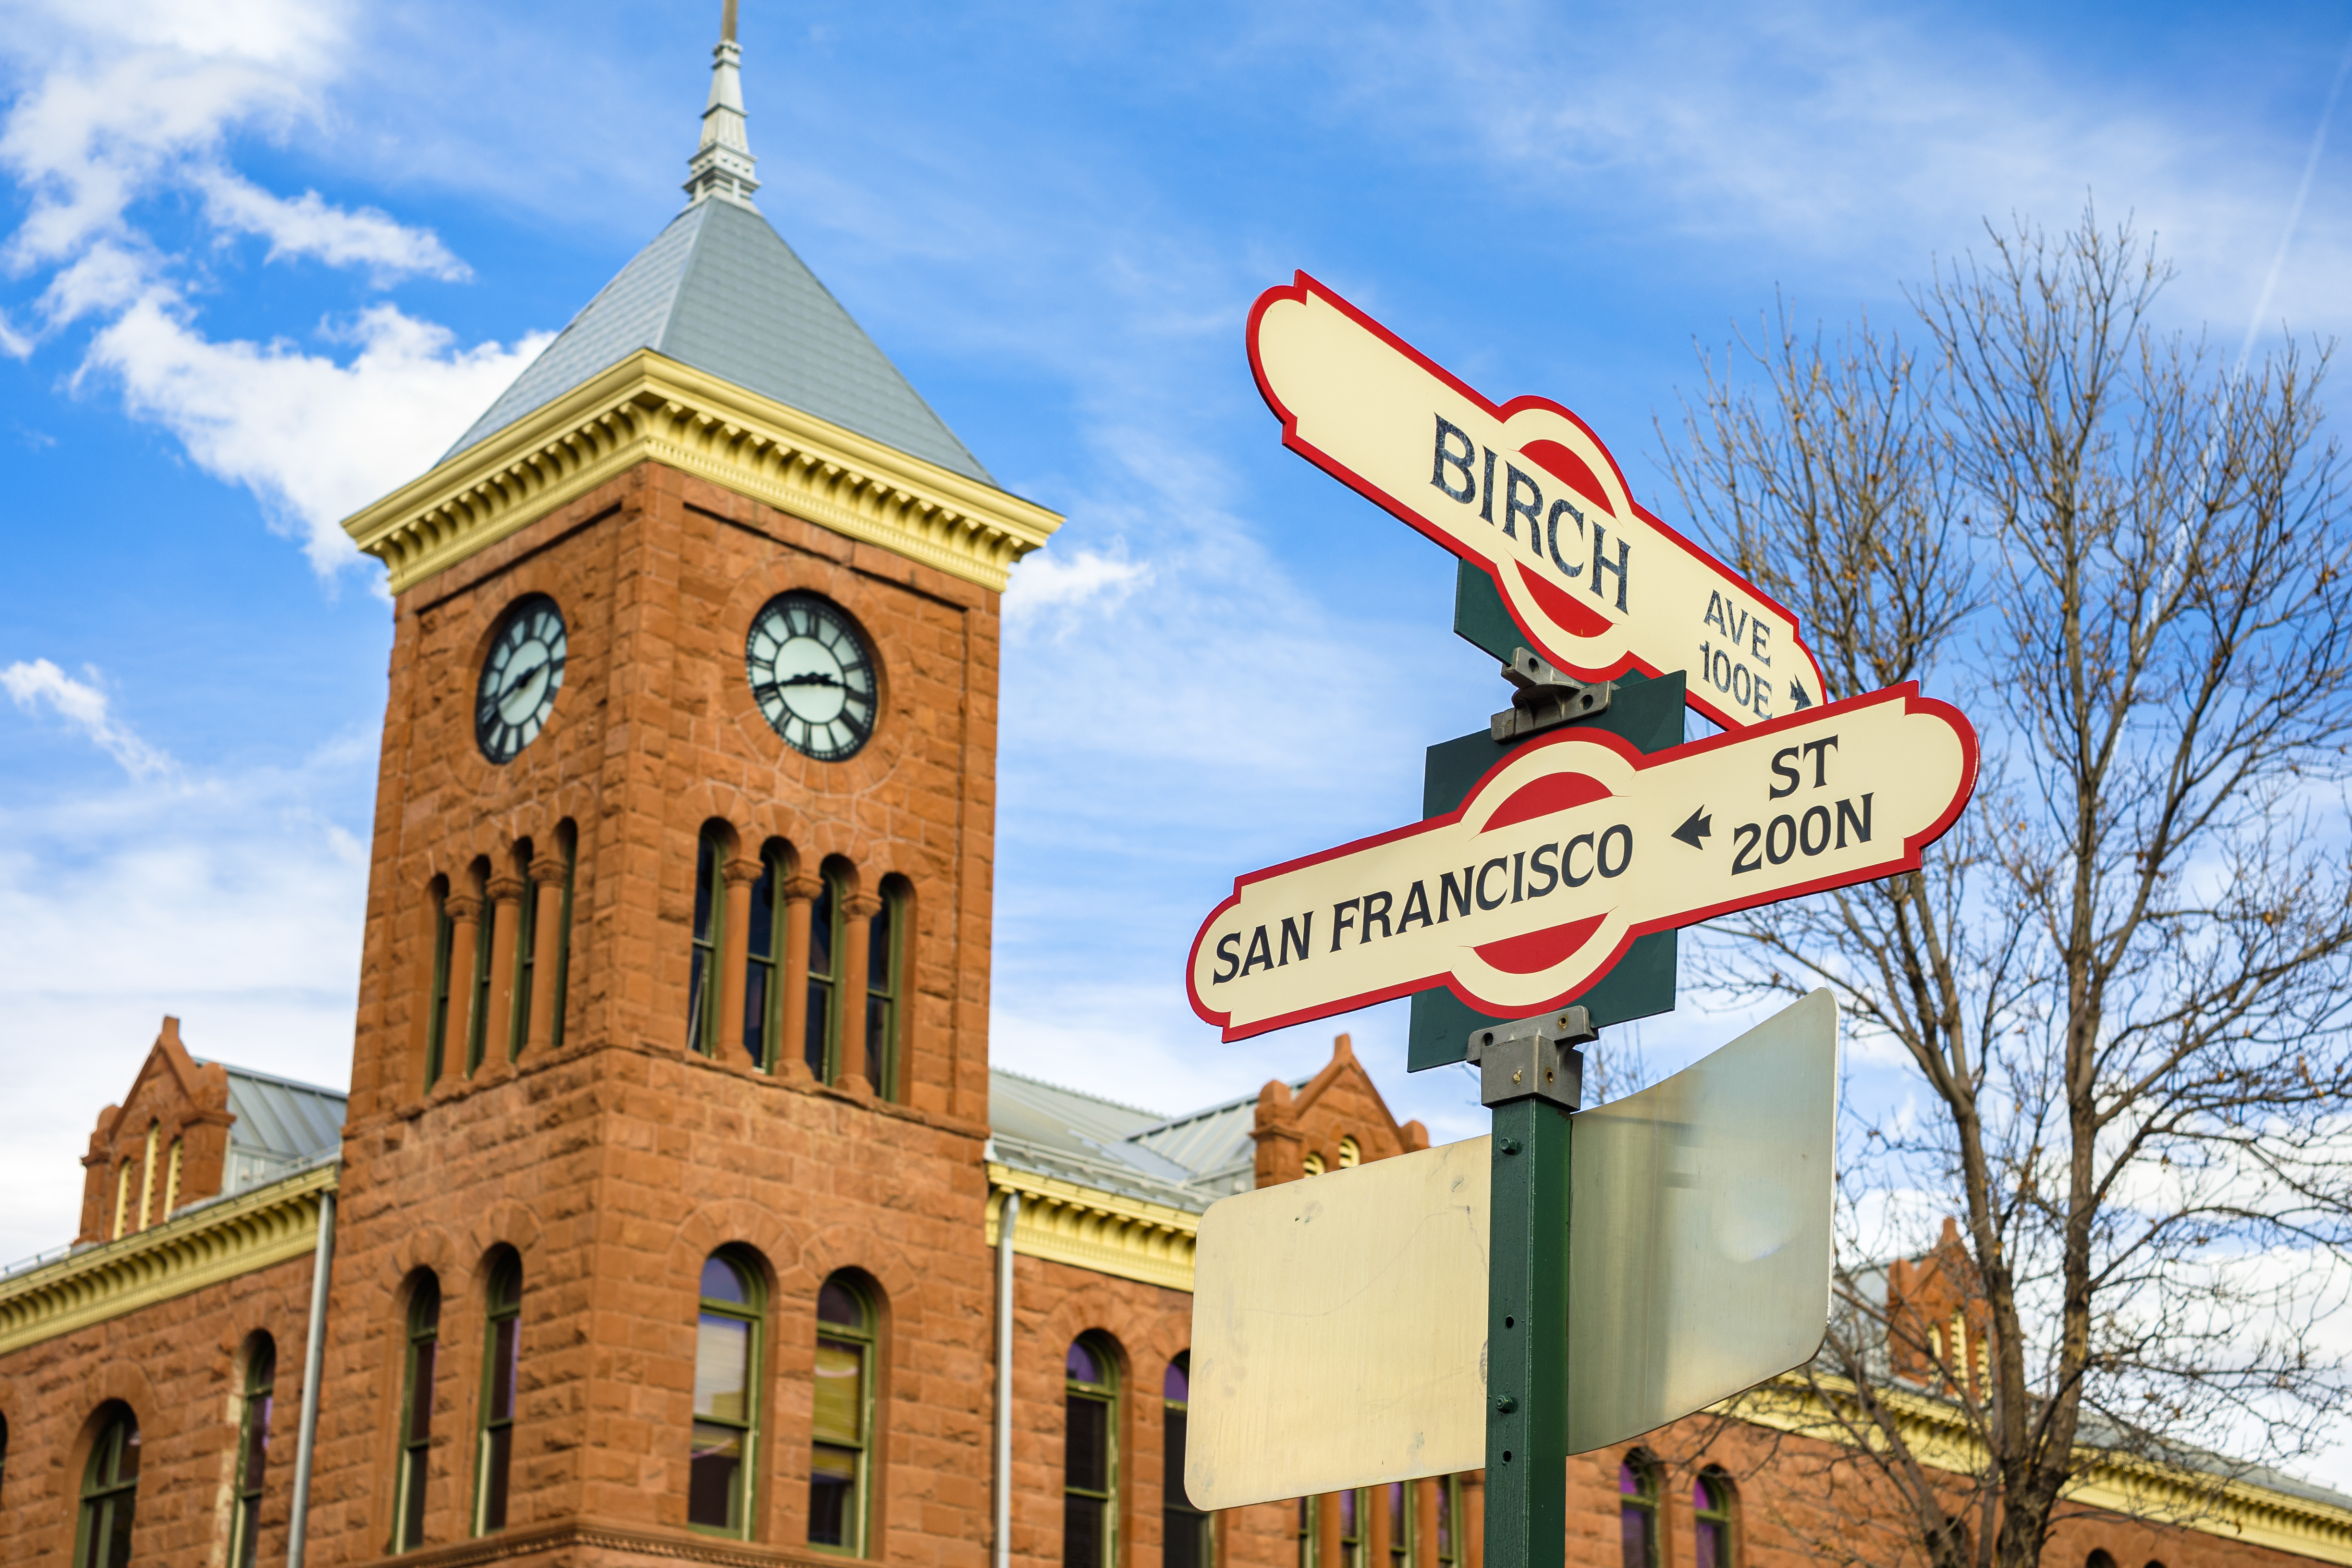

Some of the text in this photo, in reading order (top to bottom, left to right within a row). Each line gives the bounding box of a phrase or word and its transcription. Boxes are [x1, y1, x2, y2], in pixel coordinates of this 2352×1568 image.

[1429, 411, 1631, 616] BIRCH
[1703, 589, 1771, 669] AVE
[1699, 640, 1773, 720] 100E
[1769, 734, 1838, 801] ST
[1731, 792, 1874, 876] 200N
[1213, 823, 1633, 986] SAN FRANCISCO
